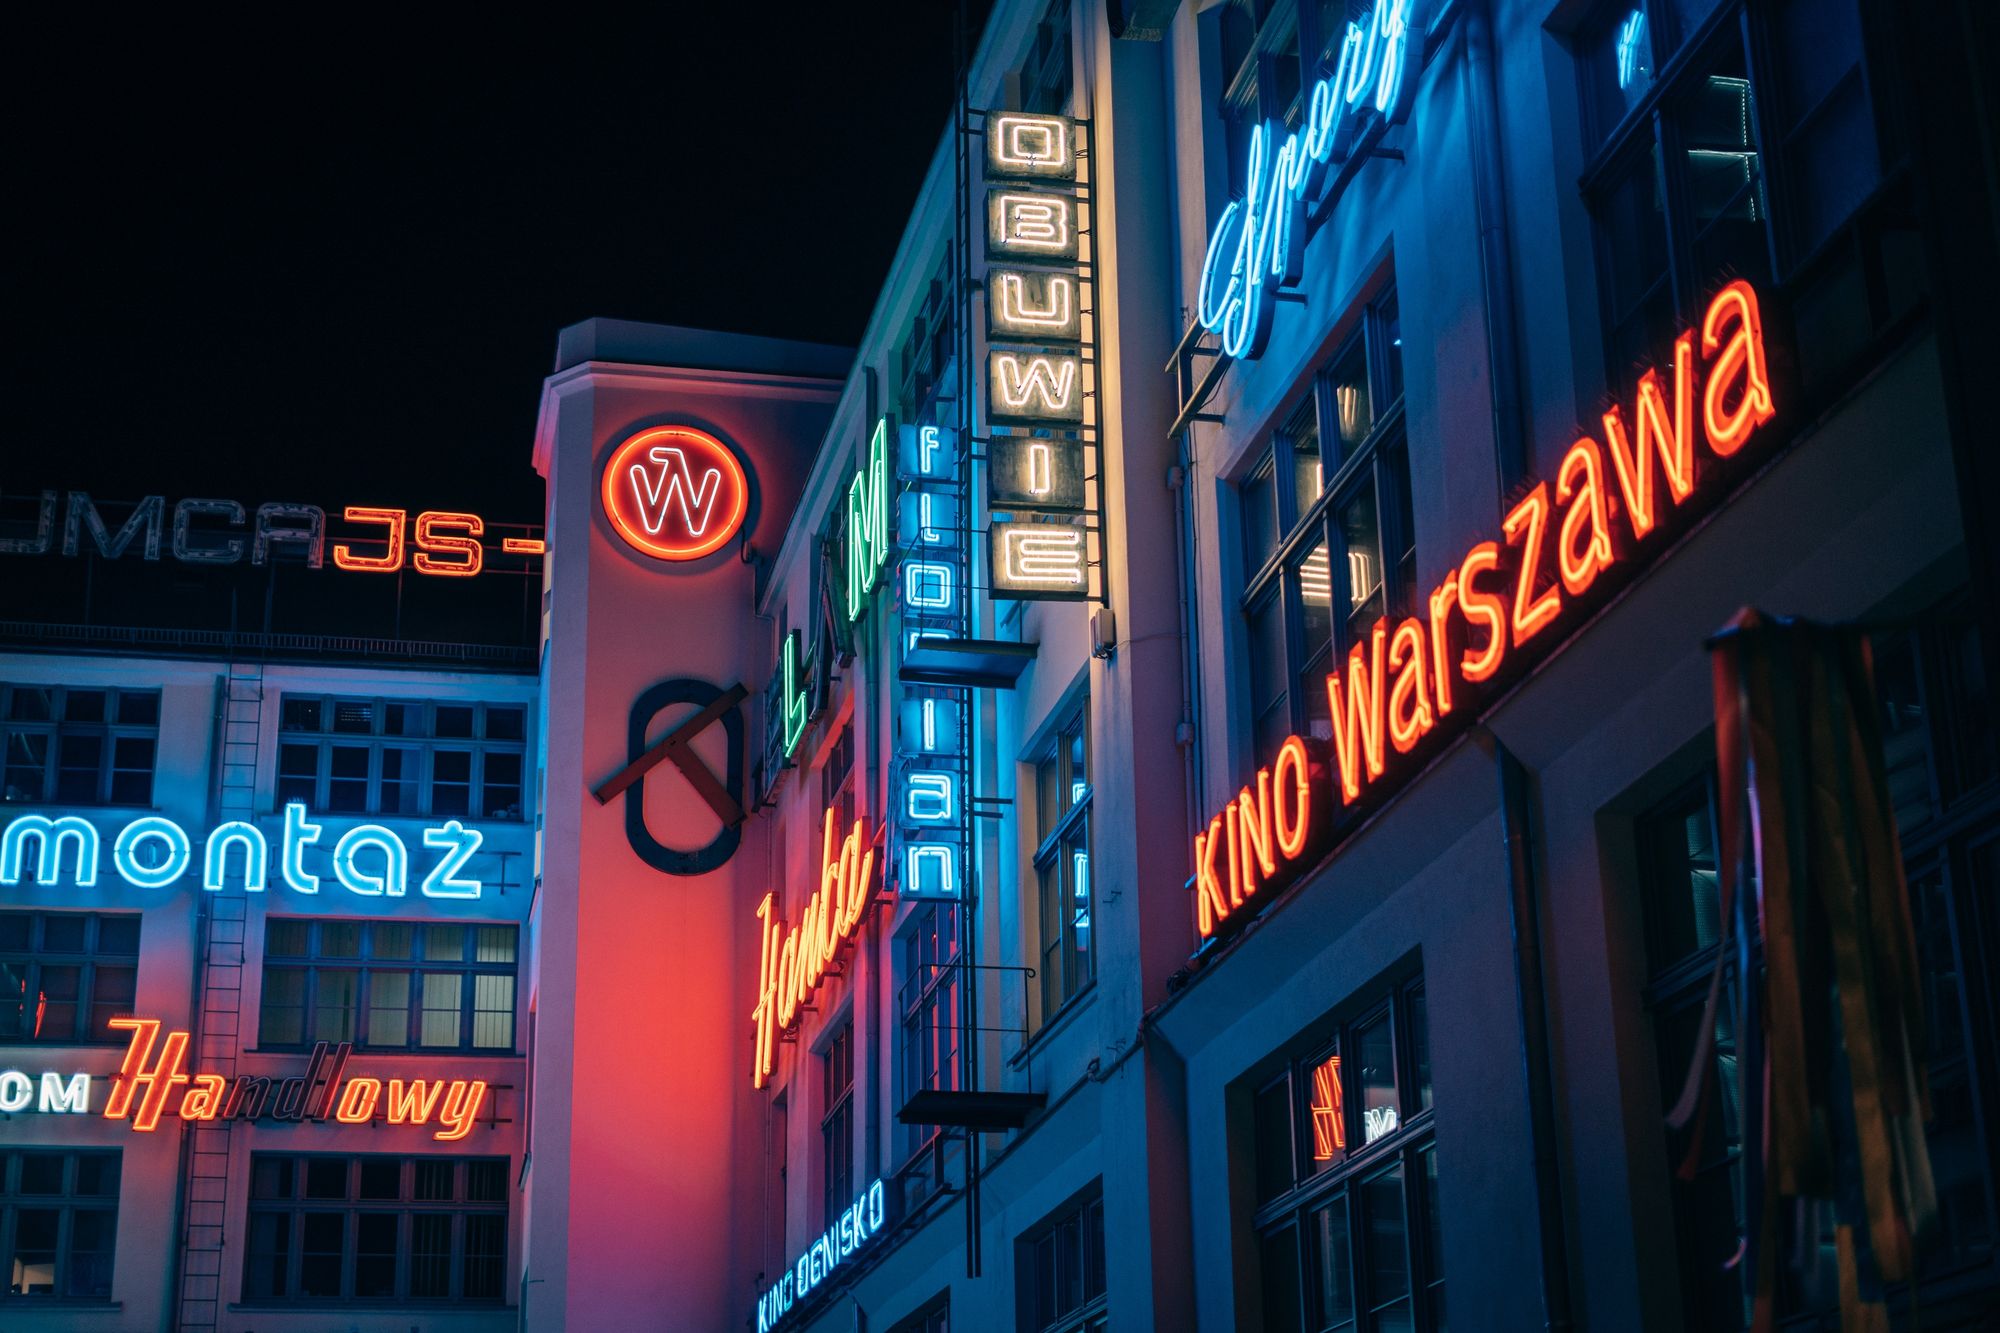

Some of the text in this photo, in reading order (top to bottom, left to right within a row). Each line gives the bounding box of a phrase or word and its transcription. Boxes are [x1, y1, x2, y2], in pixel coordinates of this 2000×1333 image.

[997, 116, 1081, 584] OBUWIE
[1194, 278, 1776, 938] KINO Warszawa
[103, 1018, 487, 1141] Handlowy
[757, 1177, 884, 1333] KINO OGNISKO
